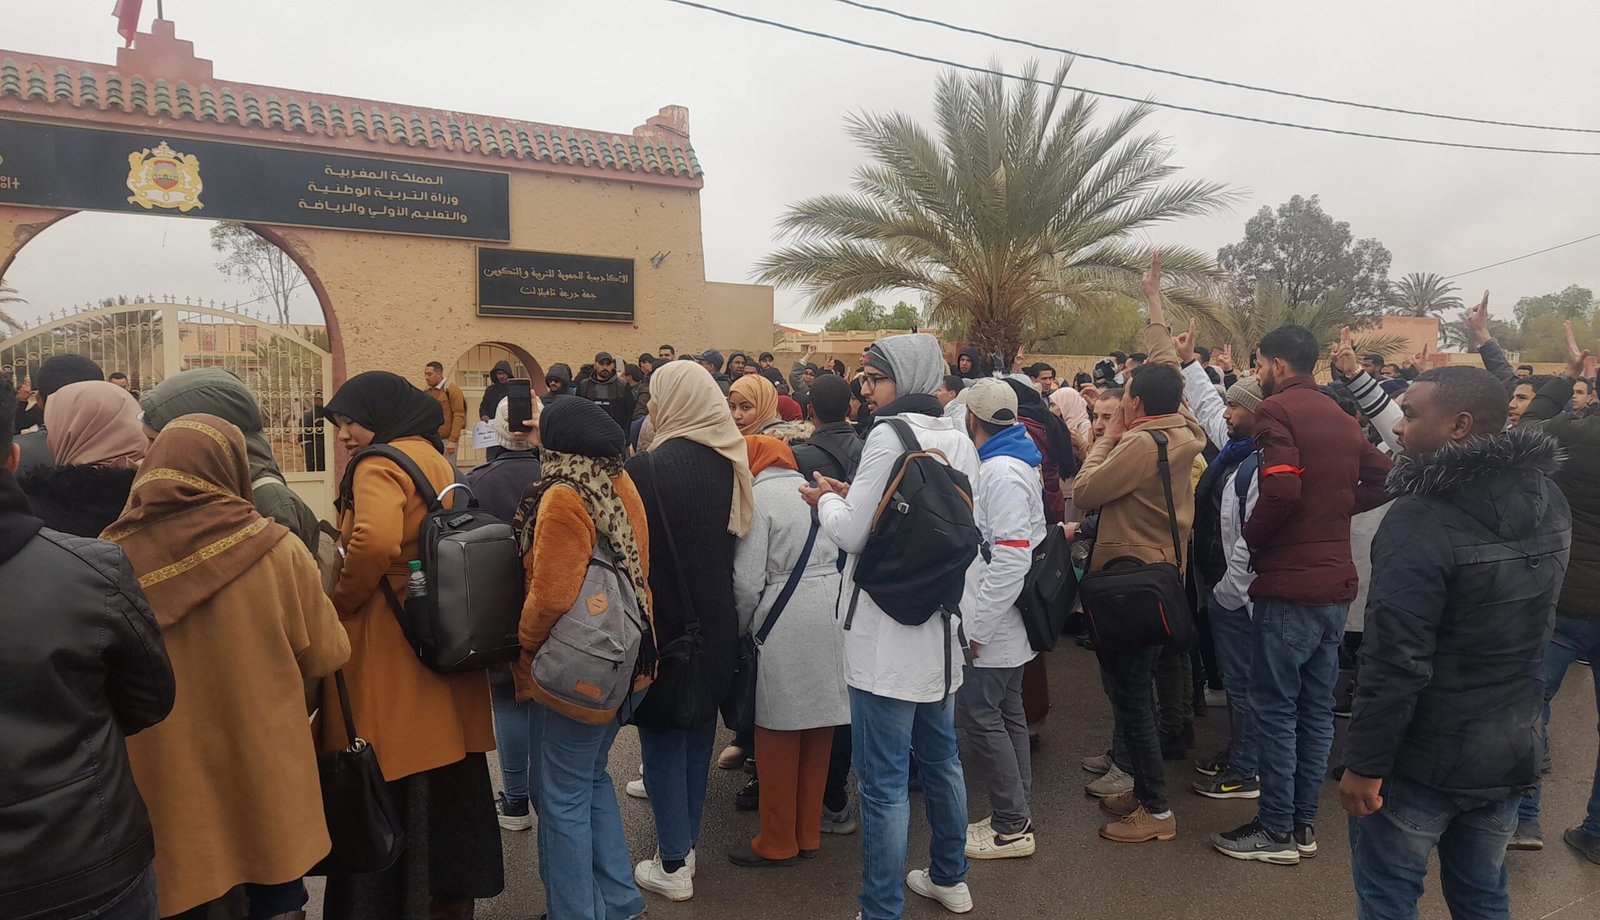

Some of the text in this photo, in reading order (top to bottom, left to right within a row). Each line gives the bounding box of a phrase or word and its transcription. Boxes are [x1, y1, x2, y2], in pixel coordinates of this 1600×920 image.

[324, 165, 444, 185] المملكة المغربية
[307, 181, 371, 198] الوطنية
[374, 187, 428, 202] التربية
[298, 199, 468, 224] والتعليم الأولي والرياضة
[483, 266, 629, 284] الأكاديمية الجهوية للتربية والتكوين
[520, 286, 598, 300] جهة درعة تافيلالت
